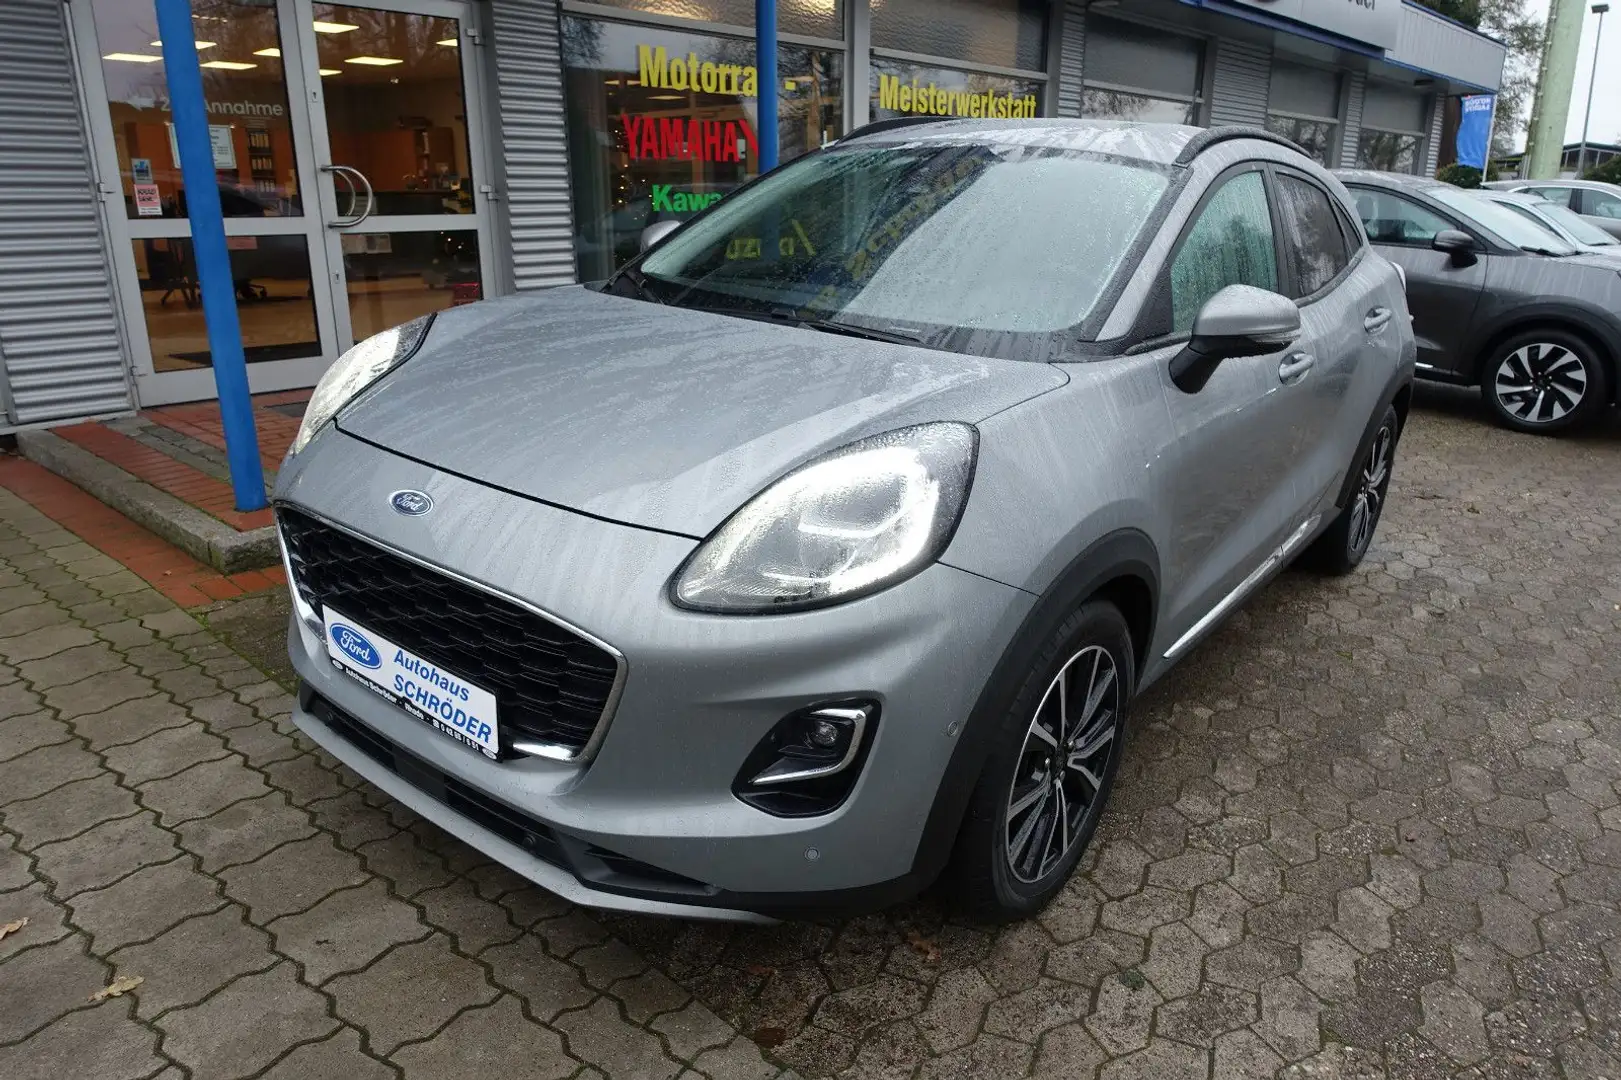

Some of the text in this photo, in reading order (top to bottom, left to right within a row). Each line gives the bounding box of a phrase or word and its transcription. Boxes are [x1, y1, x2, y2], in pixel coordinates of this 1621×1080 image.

[637, 45, 796, 97] Motorra-
[879, 73, 1036, 118] Meisterwerkstatt
[621, 112, 740, 162] YAMAHA
[652, 184, 723, 212] Kawa
[394, 491, 426, 513] Ford
[338, 628, 372, 663] Ford
[394, 650, 469, 701] Autohaus
[394, 674, 492, 743] SCHRÖDER
